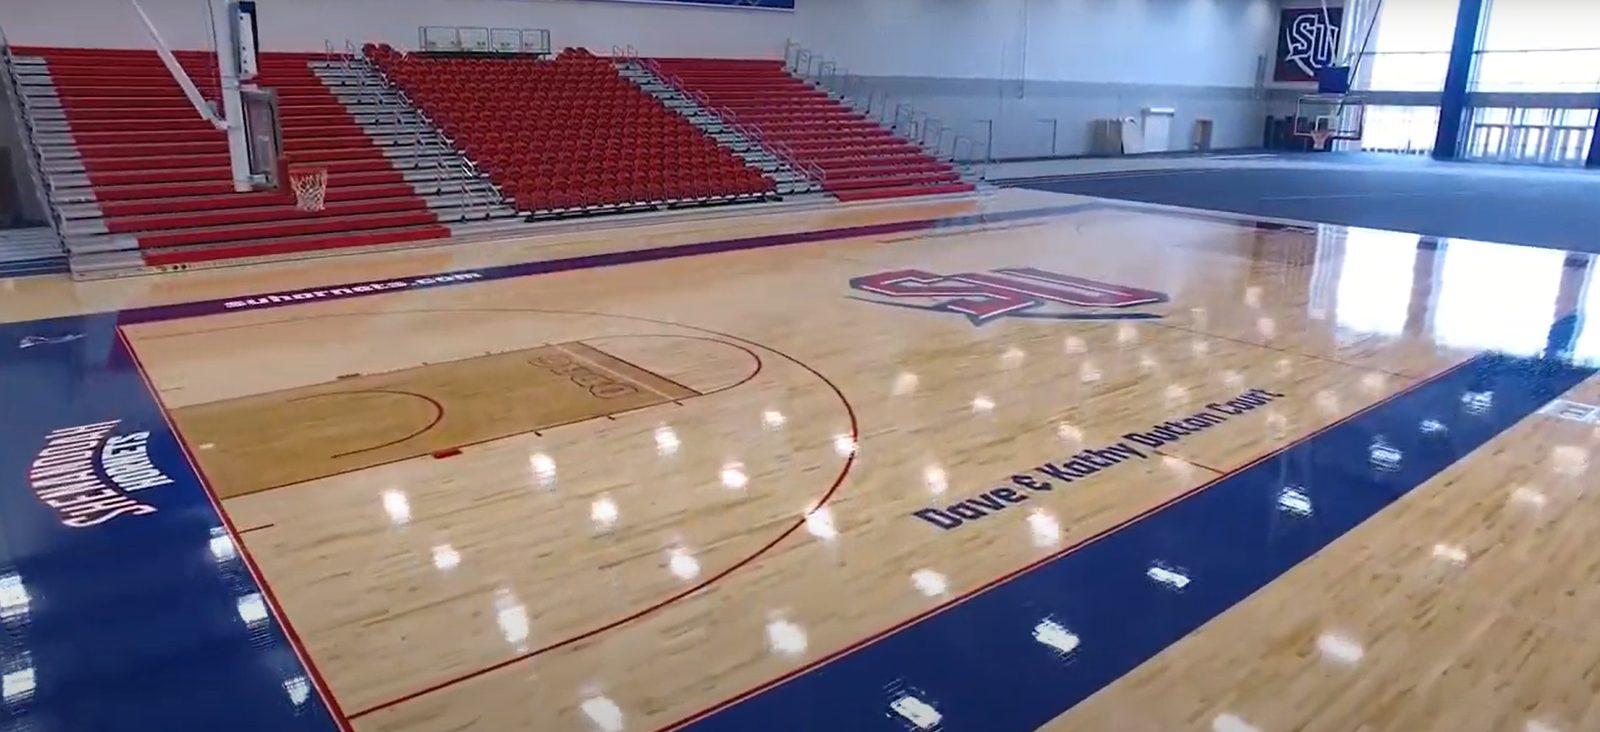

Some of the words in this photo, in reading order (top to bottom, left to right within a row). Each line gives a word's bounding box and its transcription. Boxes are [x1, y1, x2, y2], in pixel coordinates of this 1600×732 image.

[223, 271, 483, 310] suhornets.com
[29, 418, 159, 528] SHENANDOAH
[101, 430, 176, 493] HORNETS
[912, 486, 1030, 531] Dave
[1035, 442, 1148, 482] Kathy
[1121, 412, 1228, 448] Dutton
[1204, 388, 1286, 416] Court
